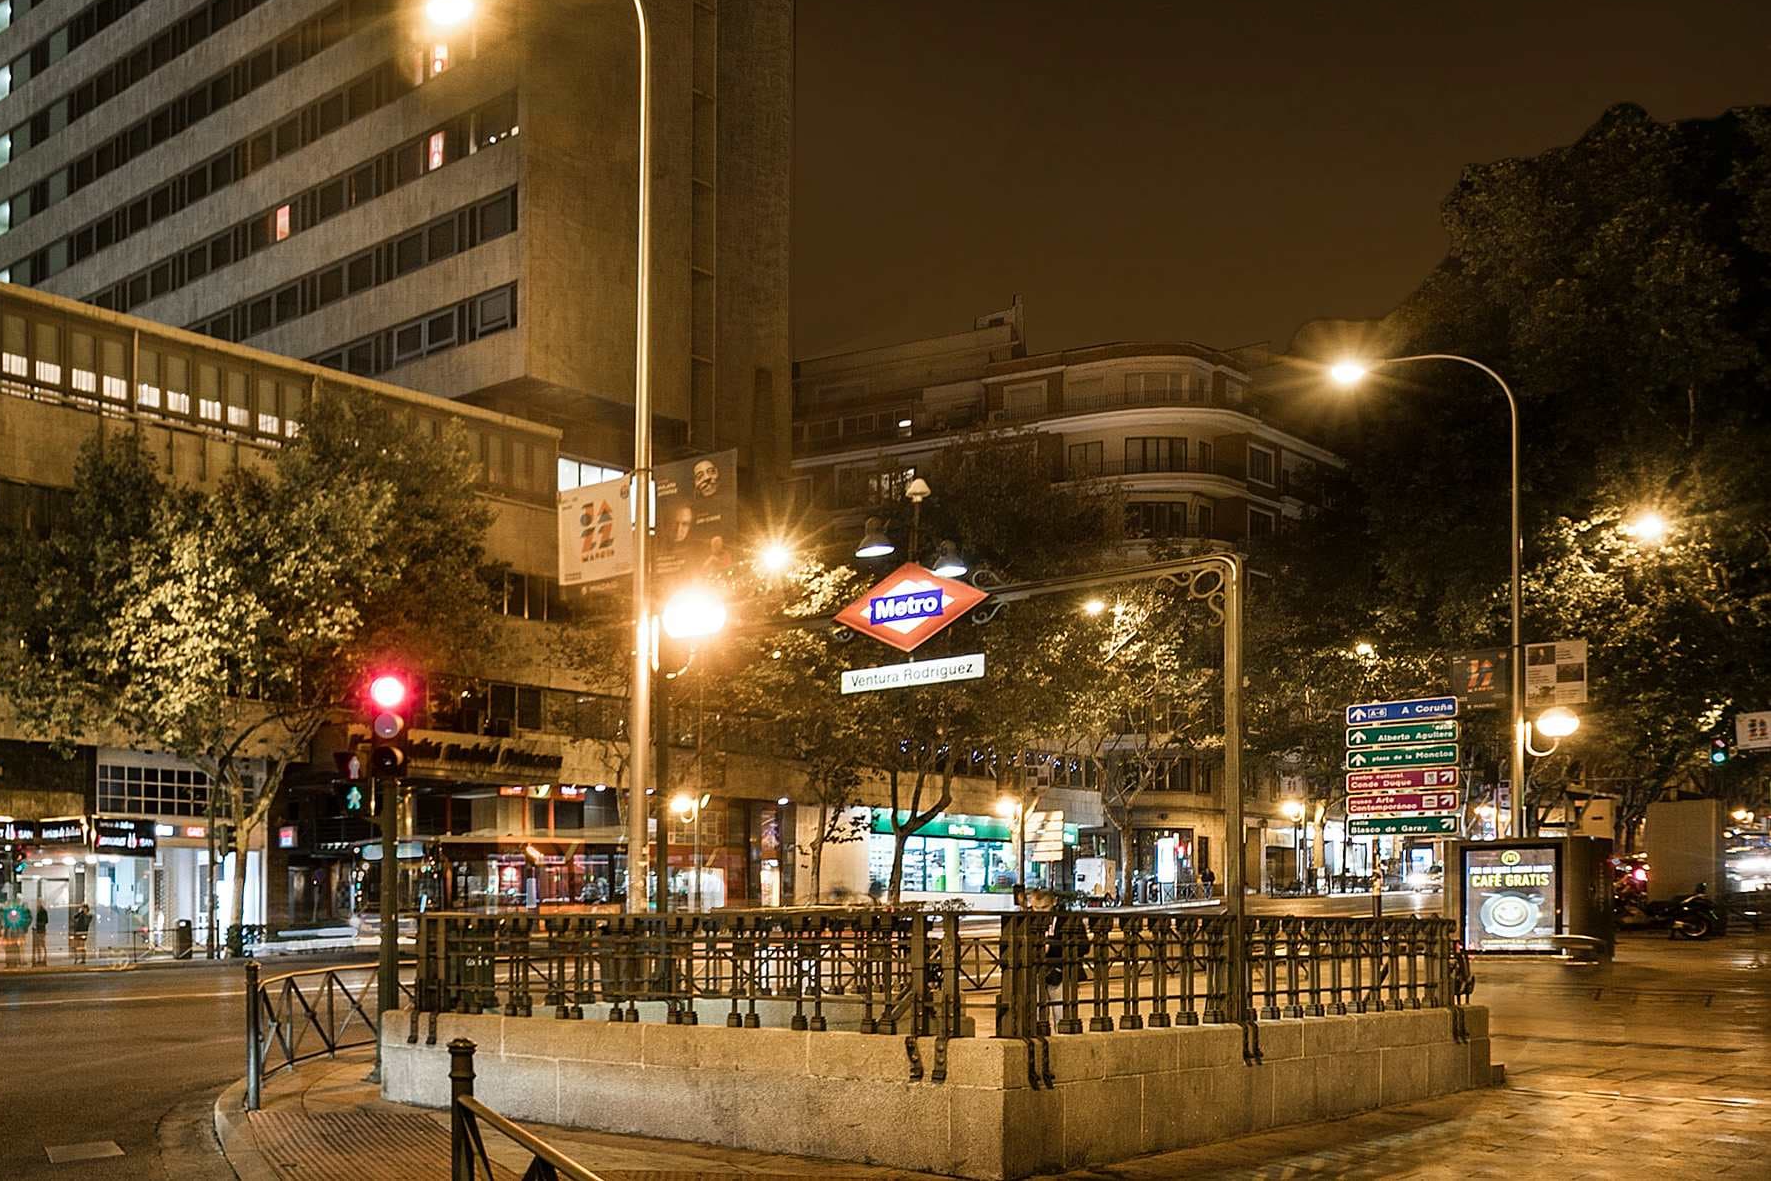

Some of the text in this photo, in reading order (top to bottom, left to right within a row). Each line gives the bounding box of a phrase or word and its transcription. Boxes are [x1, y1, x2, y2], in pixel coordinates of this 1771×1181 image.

[875, 595, 938, 620] Metro
[851, 673, 900, 687] Ventura
[1370, 703, 1454, 717] A-6 A Coruña
[1377, 730, 1454, 742] Alberto Aguilera
[1415, 750, 1454, 759] Moncloa
[1350, 779, 1412, 789] Conde Duque
[1375, 796, 1395, 804] Arte
[1350, 803, 1418, 812] Contemporáneo
[1351, 825, 1428, 834] Blasco de Garay
[1471, 873, 1550, 887] CAFÉ GRATIS
